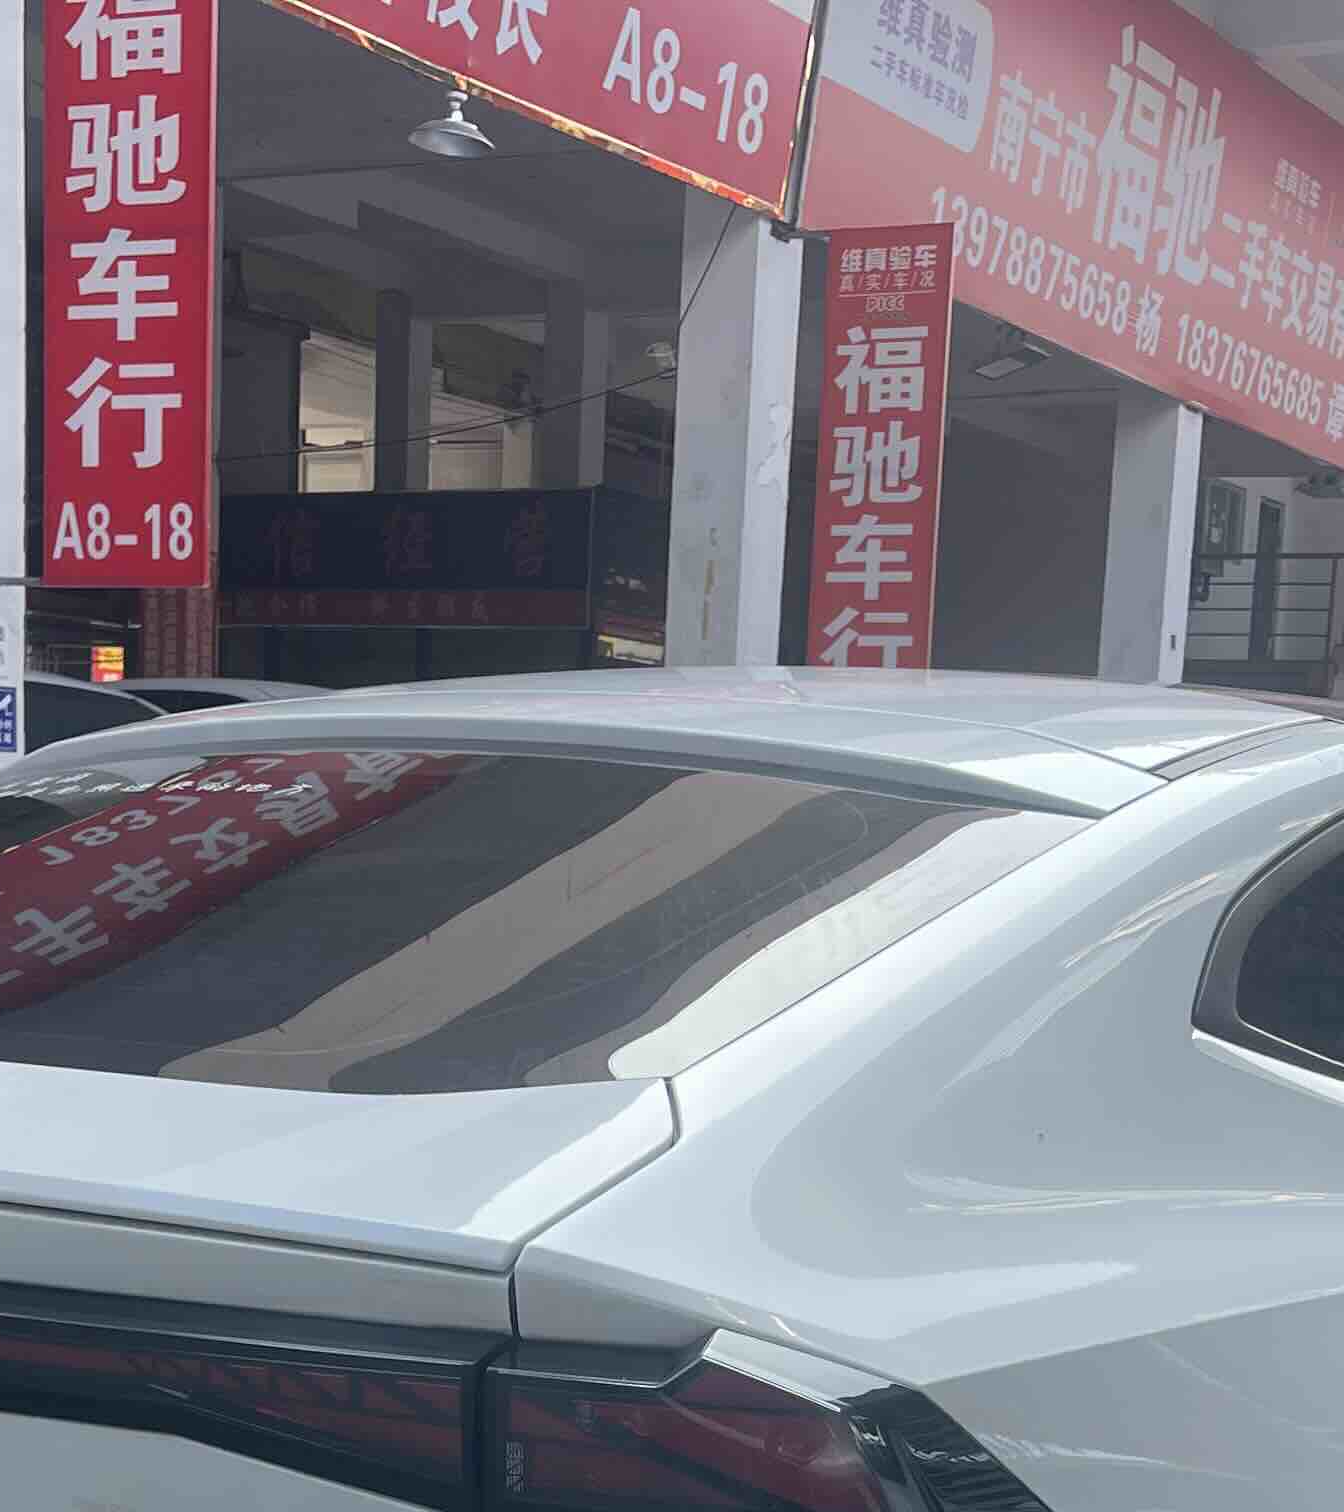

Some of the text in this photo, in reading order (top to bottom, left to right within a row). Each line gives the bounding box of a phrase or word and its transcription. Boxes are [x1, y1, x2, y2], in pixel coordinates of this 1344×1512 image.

[602, 7, 770, 154] A8-18
[64, 0, 188, 469] 福驰车行
[840, 244, 937, 273] 维真验车
[931, 186, 1132, 336] 13978875658
[1175, 313, 1324, 426] 18376765685
[53, 501, 194, 560] A8-18
[820, 326, 931, 668] 福驰车行
